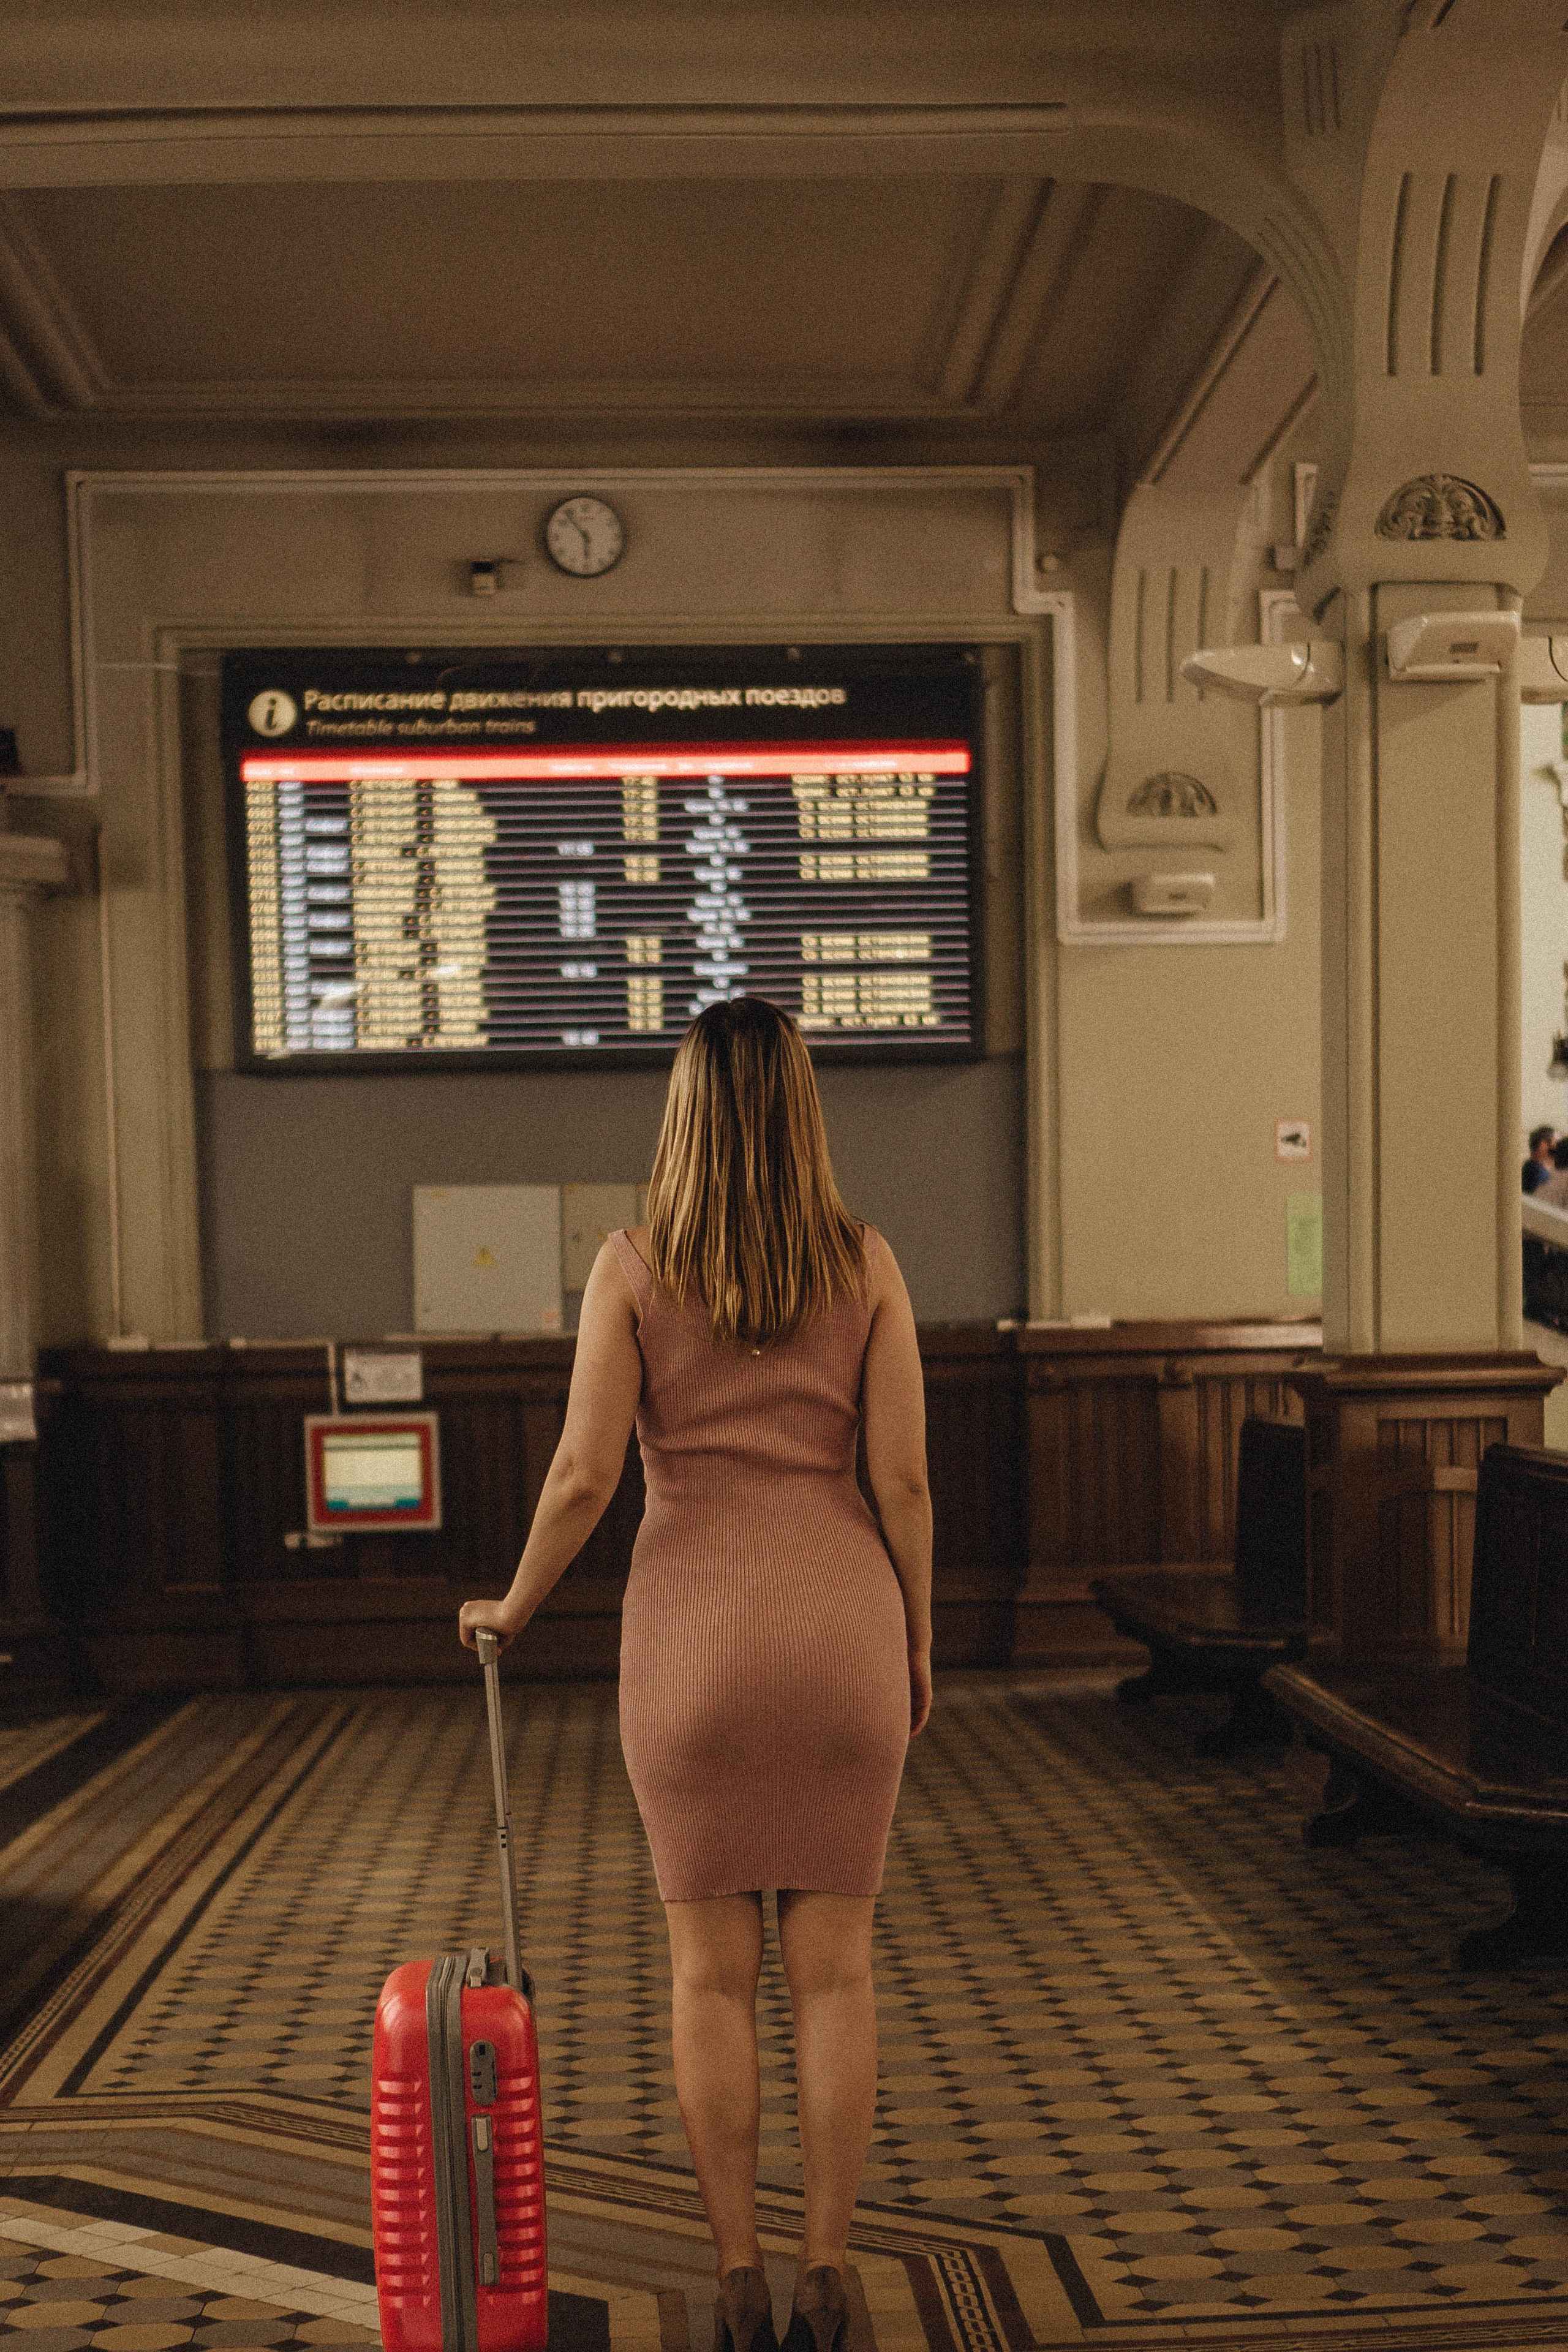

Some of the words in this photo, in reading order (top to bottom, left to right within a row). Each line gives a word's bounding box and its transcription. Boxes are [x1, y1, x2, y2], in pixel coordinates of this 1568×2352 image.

[304, 690, 446, 711] Расписание
[448, 690, 573, 712] движения
[577, 687, 742, 714] пригородных
[745, 687, 846, 709] поездов
[306, 718, 393, 736] Timetable
